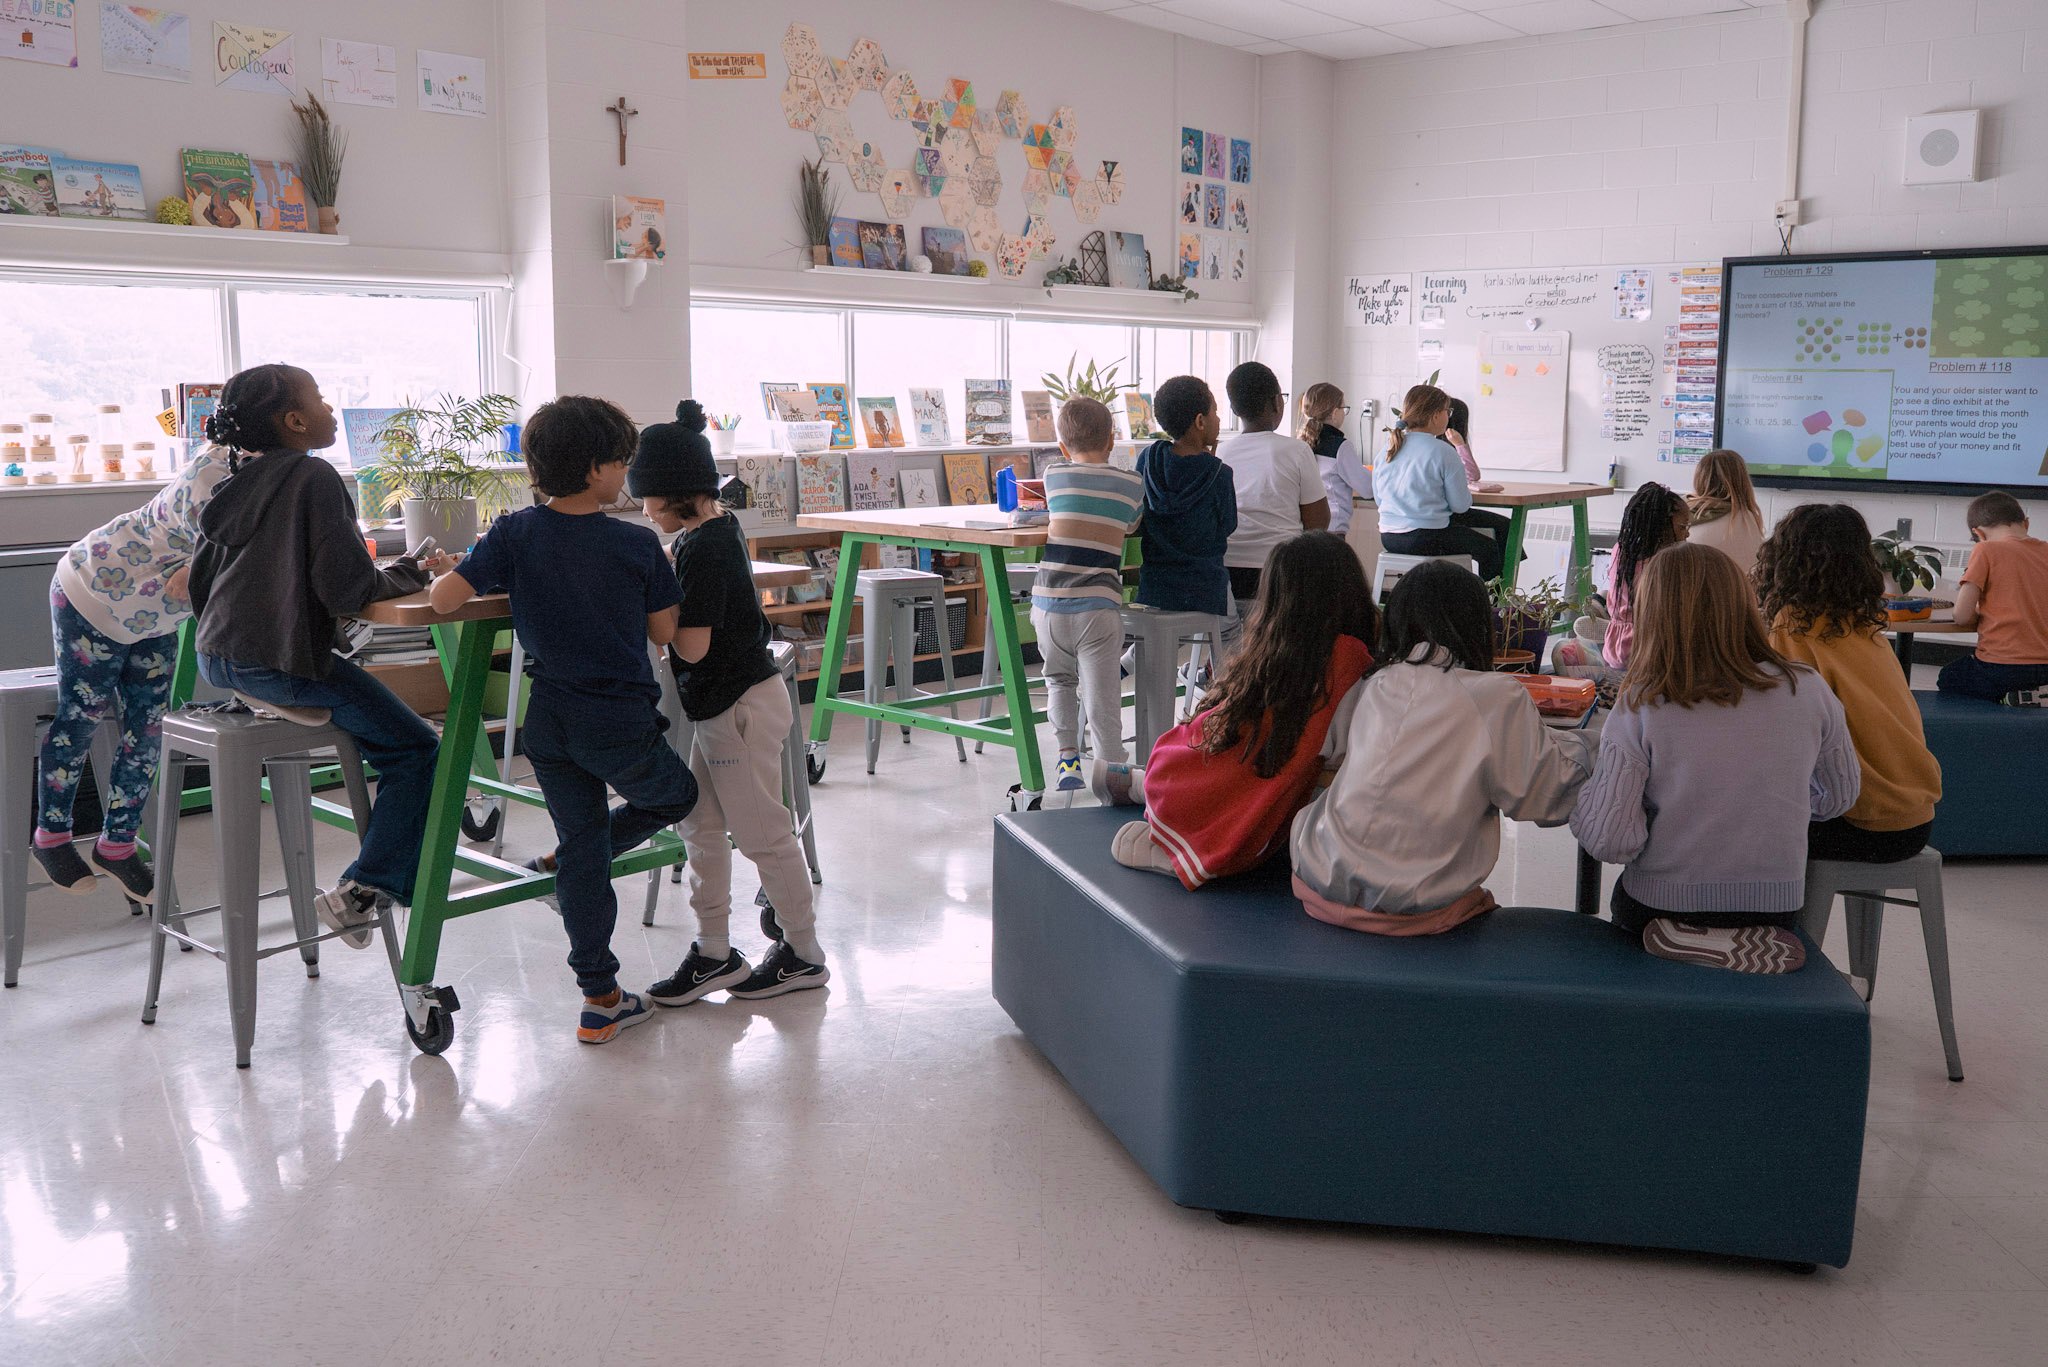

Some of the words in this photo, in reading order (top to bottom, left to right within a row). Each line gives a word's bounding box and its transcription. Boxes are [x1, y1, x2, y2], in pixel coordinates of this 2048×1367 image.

[217, 36, 295, 80] Courageous
[0, 153, 49, 163] Everybody
[187, 155, 205, 165] THE
[207, 157, 249, 168] BIRDMAN
[1763, 266, 1803, 277] Problem
[1805, 267, 1812, 275] #
[1816, 266, 1833, 275] 129
[1349, 278, 1369, 296] How
[1372, 279, 1390, 294] will
[1393, 285, 1409, 300] you
[1425, 276, 1467, 294] Learning
[1430, 289, 1457, 303] Goals
[1736, 292, 1757, 300] Three
[1758, 291, 1803, 299] consecutive
[1804, 290, 1838, 298] numbers
[1359, 296, 1382, 310] Make
[1385, 299, 1404, 314] your
[1807, 300, 1828, 308] What
[1365, 311, 1399, 325] Mark?
[1735, 311, 1771, 319] numbers?
[1605, 351, 1630, 361] Thinking
[1929, 362, 1976, 372] Problem
[1979, 362, 1988, 371] #
[1991, 362, 2012, 371] 118
[1752, 374, 1785, 382] Problem
[1894, 386, 1911, 394] You
[1913, 386, 1929, 394] and
[1932, 387, 1951, 396] your
[1953, 386, 1975, 394] older
[1978, 386, 2002, 394] sister
[2004, 387, 2027, 395] want
[2029, 387, 2038, 395] to
[1893, 398, 1904, 407] go
[1932, 397, 1951, 405] dino
[1953, 397, 1982, 405] exhibit
[1995, 398, 2010, 406] the
[350, 411, 366, 421] THE
[782, 414, 806, 422] ROSIE
[914, 406, 947, 420] MAKER
[1932, 408, 1953, 416] three
[1956, 408, 1980, 417] times
[1982, 408, 1998, 417] this
[2000, 409, 2029, 418] month
[350, 423, 370, 433] WHO
[1891, 419, 1913, 427] (your
[1915, 420, 1947, 428] parents
[1950, 420, 1976, 428] would
[1979, 420, 1998, 429] drop
[2001, 422, 2018, 430] you
[1938, 431, 1957, 439] plan
[1959, 431, 1986, 439] would
[1988, 431, 1999, 439] be
[2002, 432, 2016, 440] the
[1938, 442, 1958, 450] your
[1960, 443, 1990, 451] money
[1992, 443, 2010, 451] and
[2012, 443, 2021, 451] fit
[1889, 452, 1908, 460] your
[1910, 451, 1942, 459] needs?
[800, 485, 825, 495] AARON
[853, 483, 870, 491] ADA
[855, 500, 894, 510] SCIENTIST
